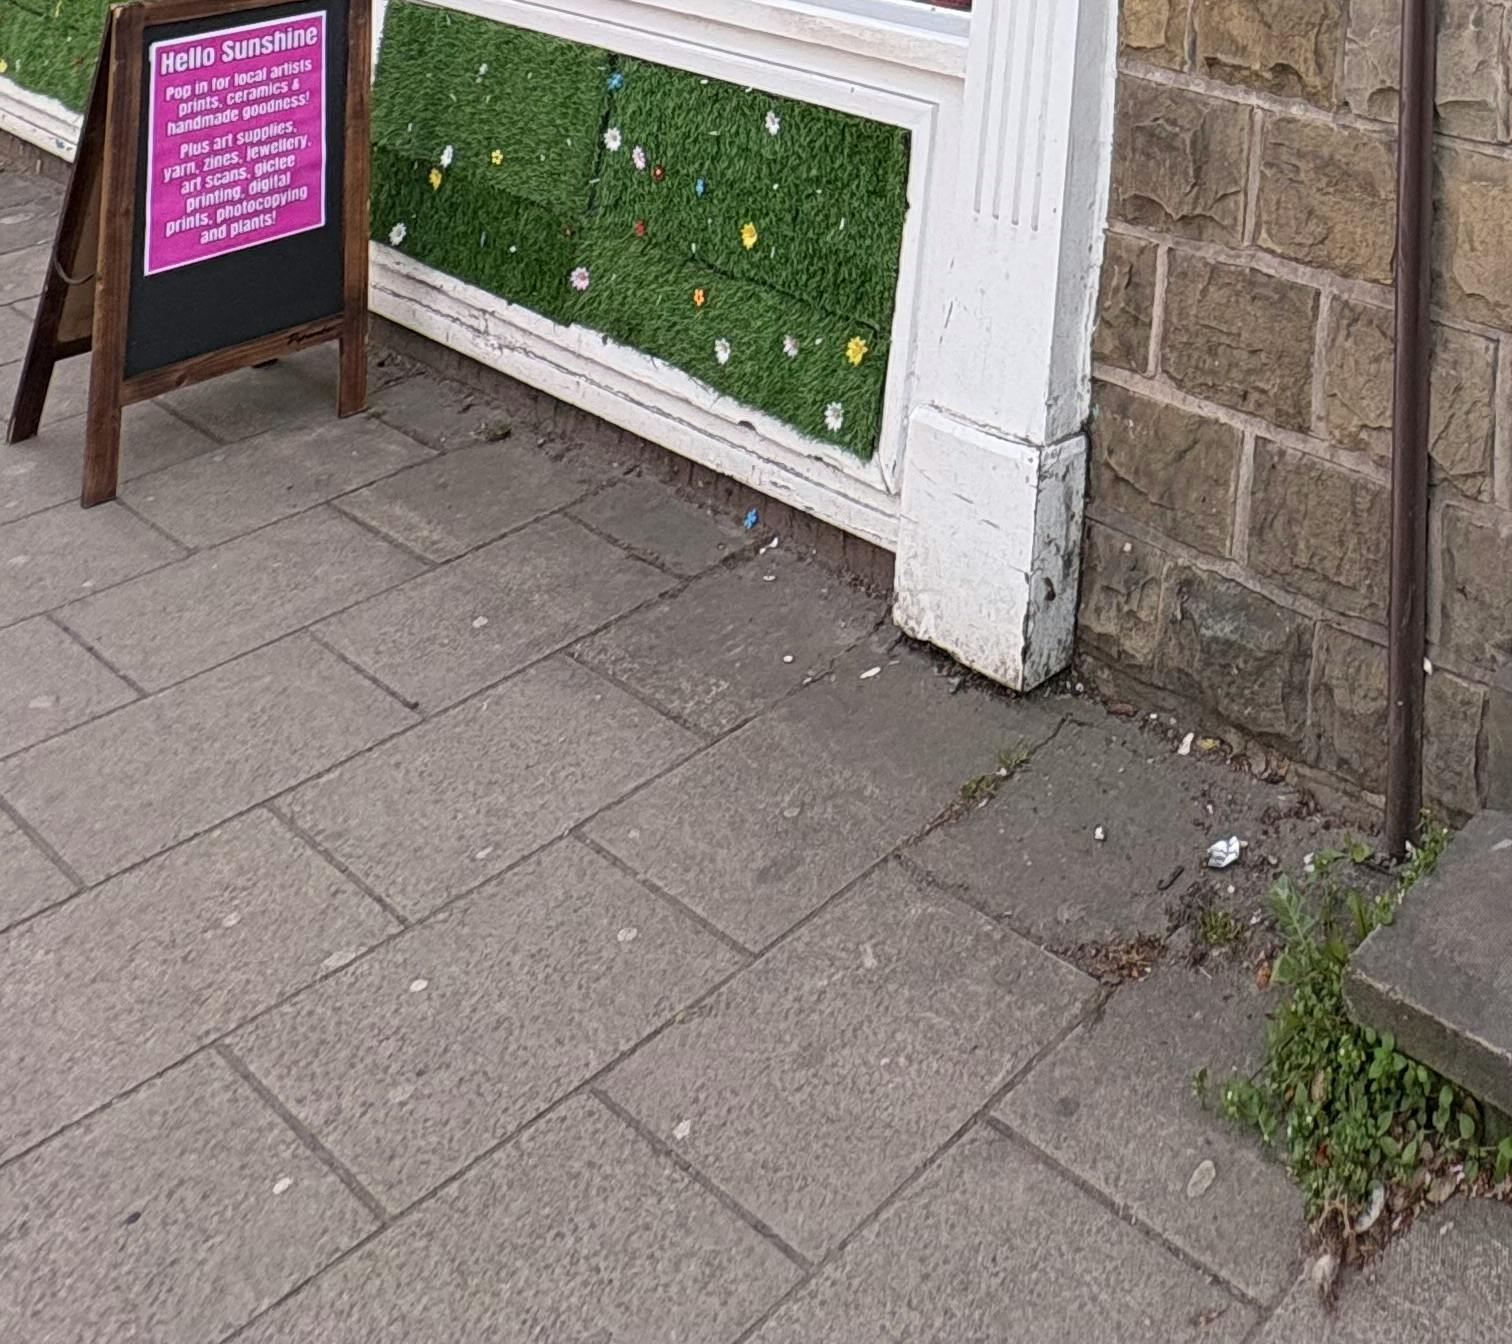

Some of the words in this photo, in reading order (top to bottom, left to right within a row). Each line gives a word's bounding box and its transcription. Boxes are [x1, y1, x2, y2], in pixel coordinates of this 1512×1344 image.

[161, 46, 215, 75] Hello
[222, 26, 318, 63] Sunshine
[166, 85, 192, 102] Pop
[195, 80, 208, 94] in
[212, 75, 231, 91] for
[234, 67, 267, 87] local
[270, 59, 312, 79] artists
[227, 81, 288, 105] ceramics
[292, 79, 300, 90] &
[167, 110, 239, 136] handmade
[242, 91, 310, 120] goodness!
[180, 140, 210, 159] Plus
[214, 134, 233, 150] art
[181, 177, 201, 194] art
[249, 172, 291, 195] digital
[216, 186, 308, 222] photocopying
[201, 228, 227, 244] and
[230, 211, 277, 238] plants!
